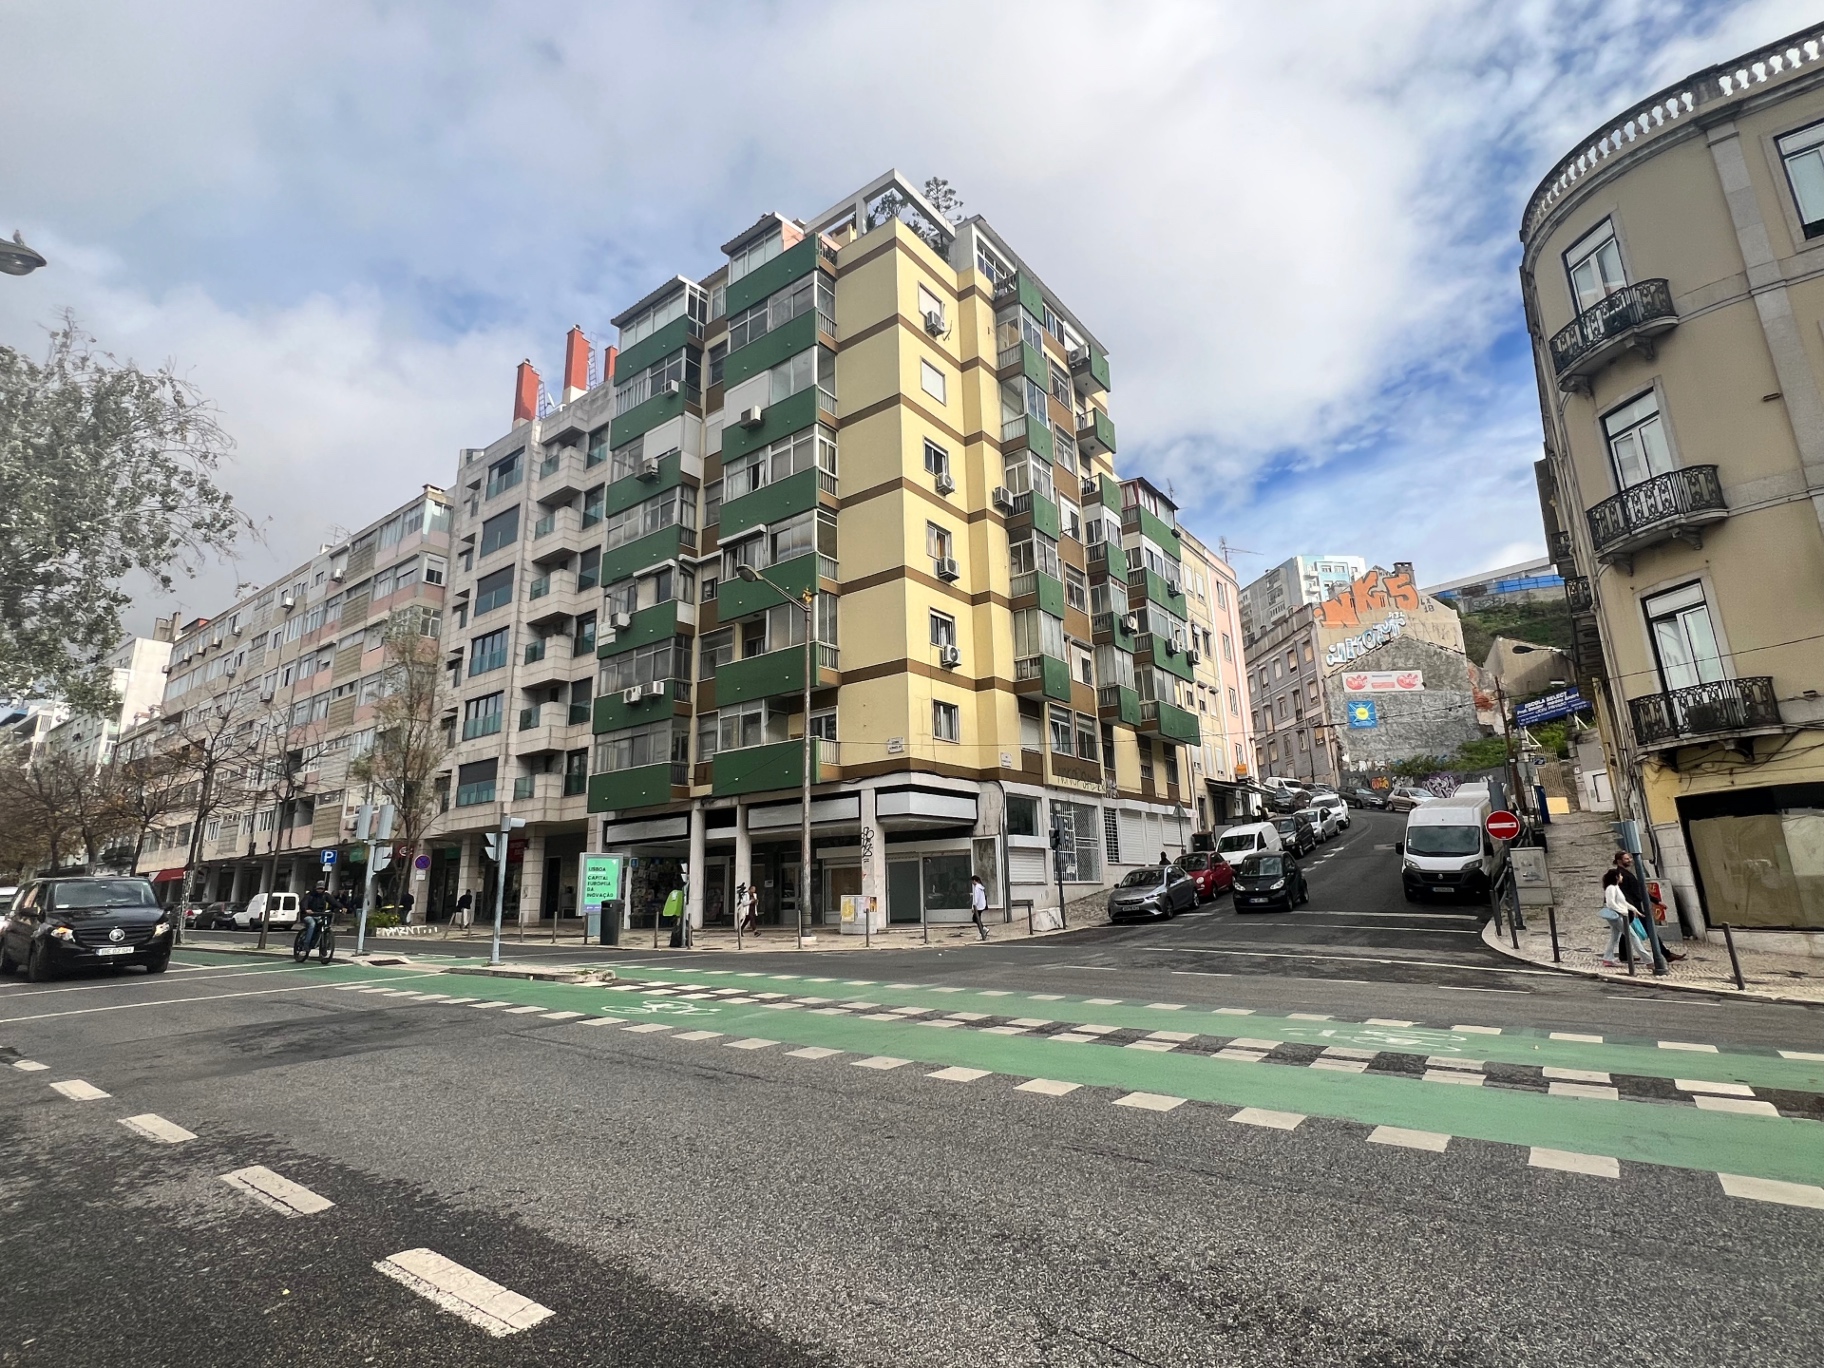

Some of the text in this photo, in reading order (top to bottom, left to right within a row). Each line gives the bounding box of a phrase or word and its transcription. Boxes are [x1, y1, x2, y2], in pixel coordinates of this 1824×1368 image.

[1525, 699, 1545, 709] ESCOLA
[1546, 691, 1567, 701] SELECT
[323, 851, 334, 862] P
